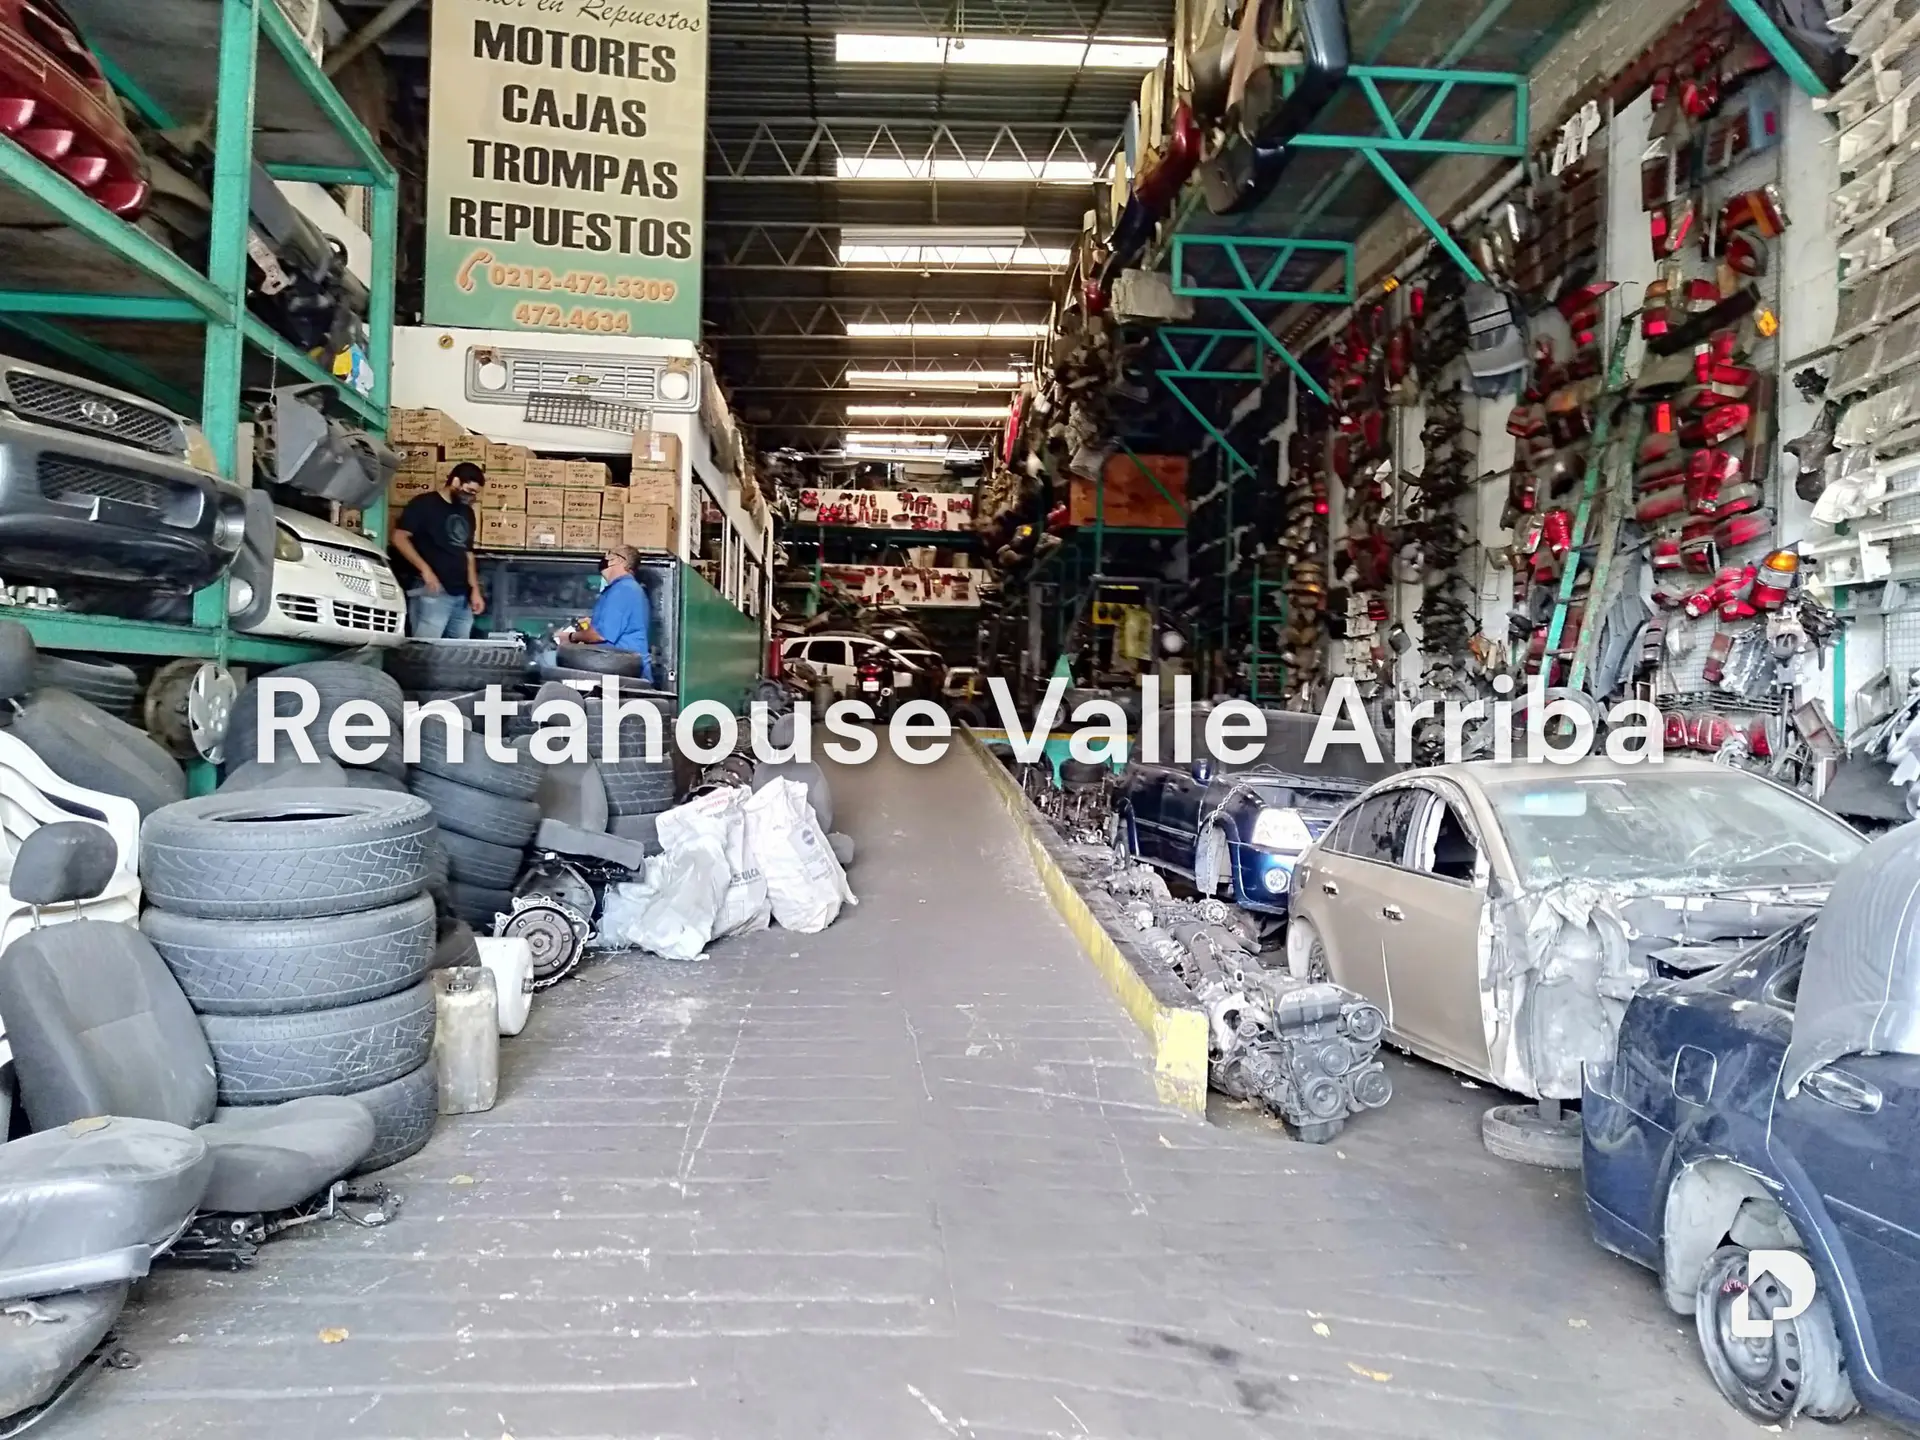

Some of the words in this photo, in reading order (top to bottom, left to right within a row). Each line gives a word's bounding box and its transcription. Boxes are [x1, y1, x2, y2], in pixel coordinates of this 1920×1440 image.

[577, 0, 703, 32] Repuestos
[473, 19, 677, 84] MOTORES
[502, 83, 648, 138] CAJAS
[467, 138, 679, 200] TROMPAS
[448, 196, 692, 260] REPUESTOS
[490, 264, 676, 302] 0212-472.3309
[515, 304, 630, 334] 472.4634
[395, 482, 430, 490] DEPO
[730, 868, 760, 884] SULCA
